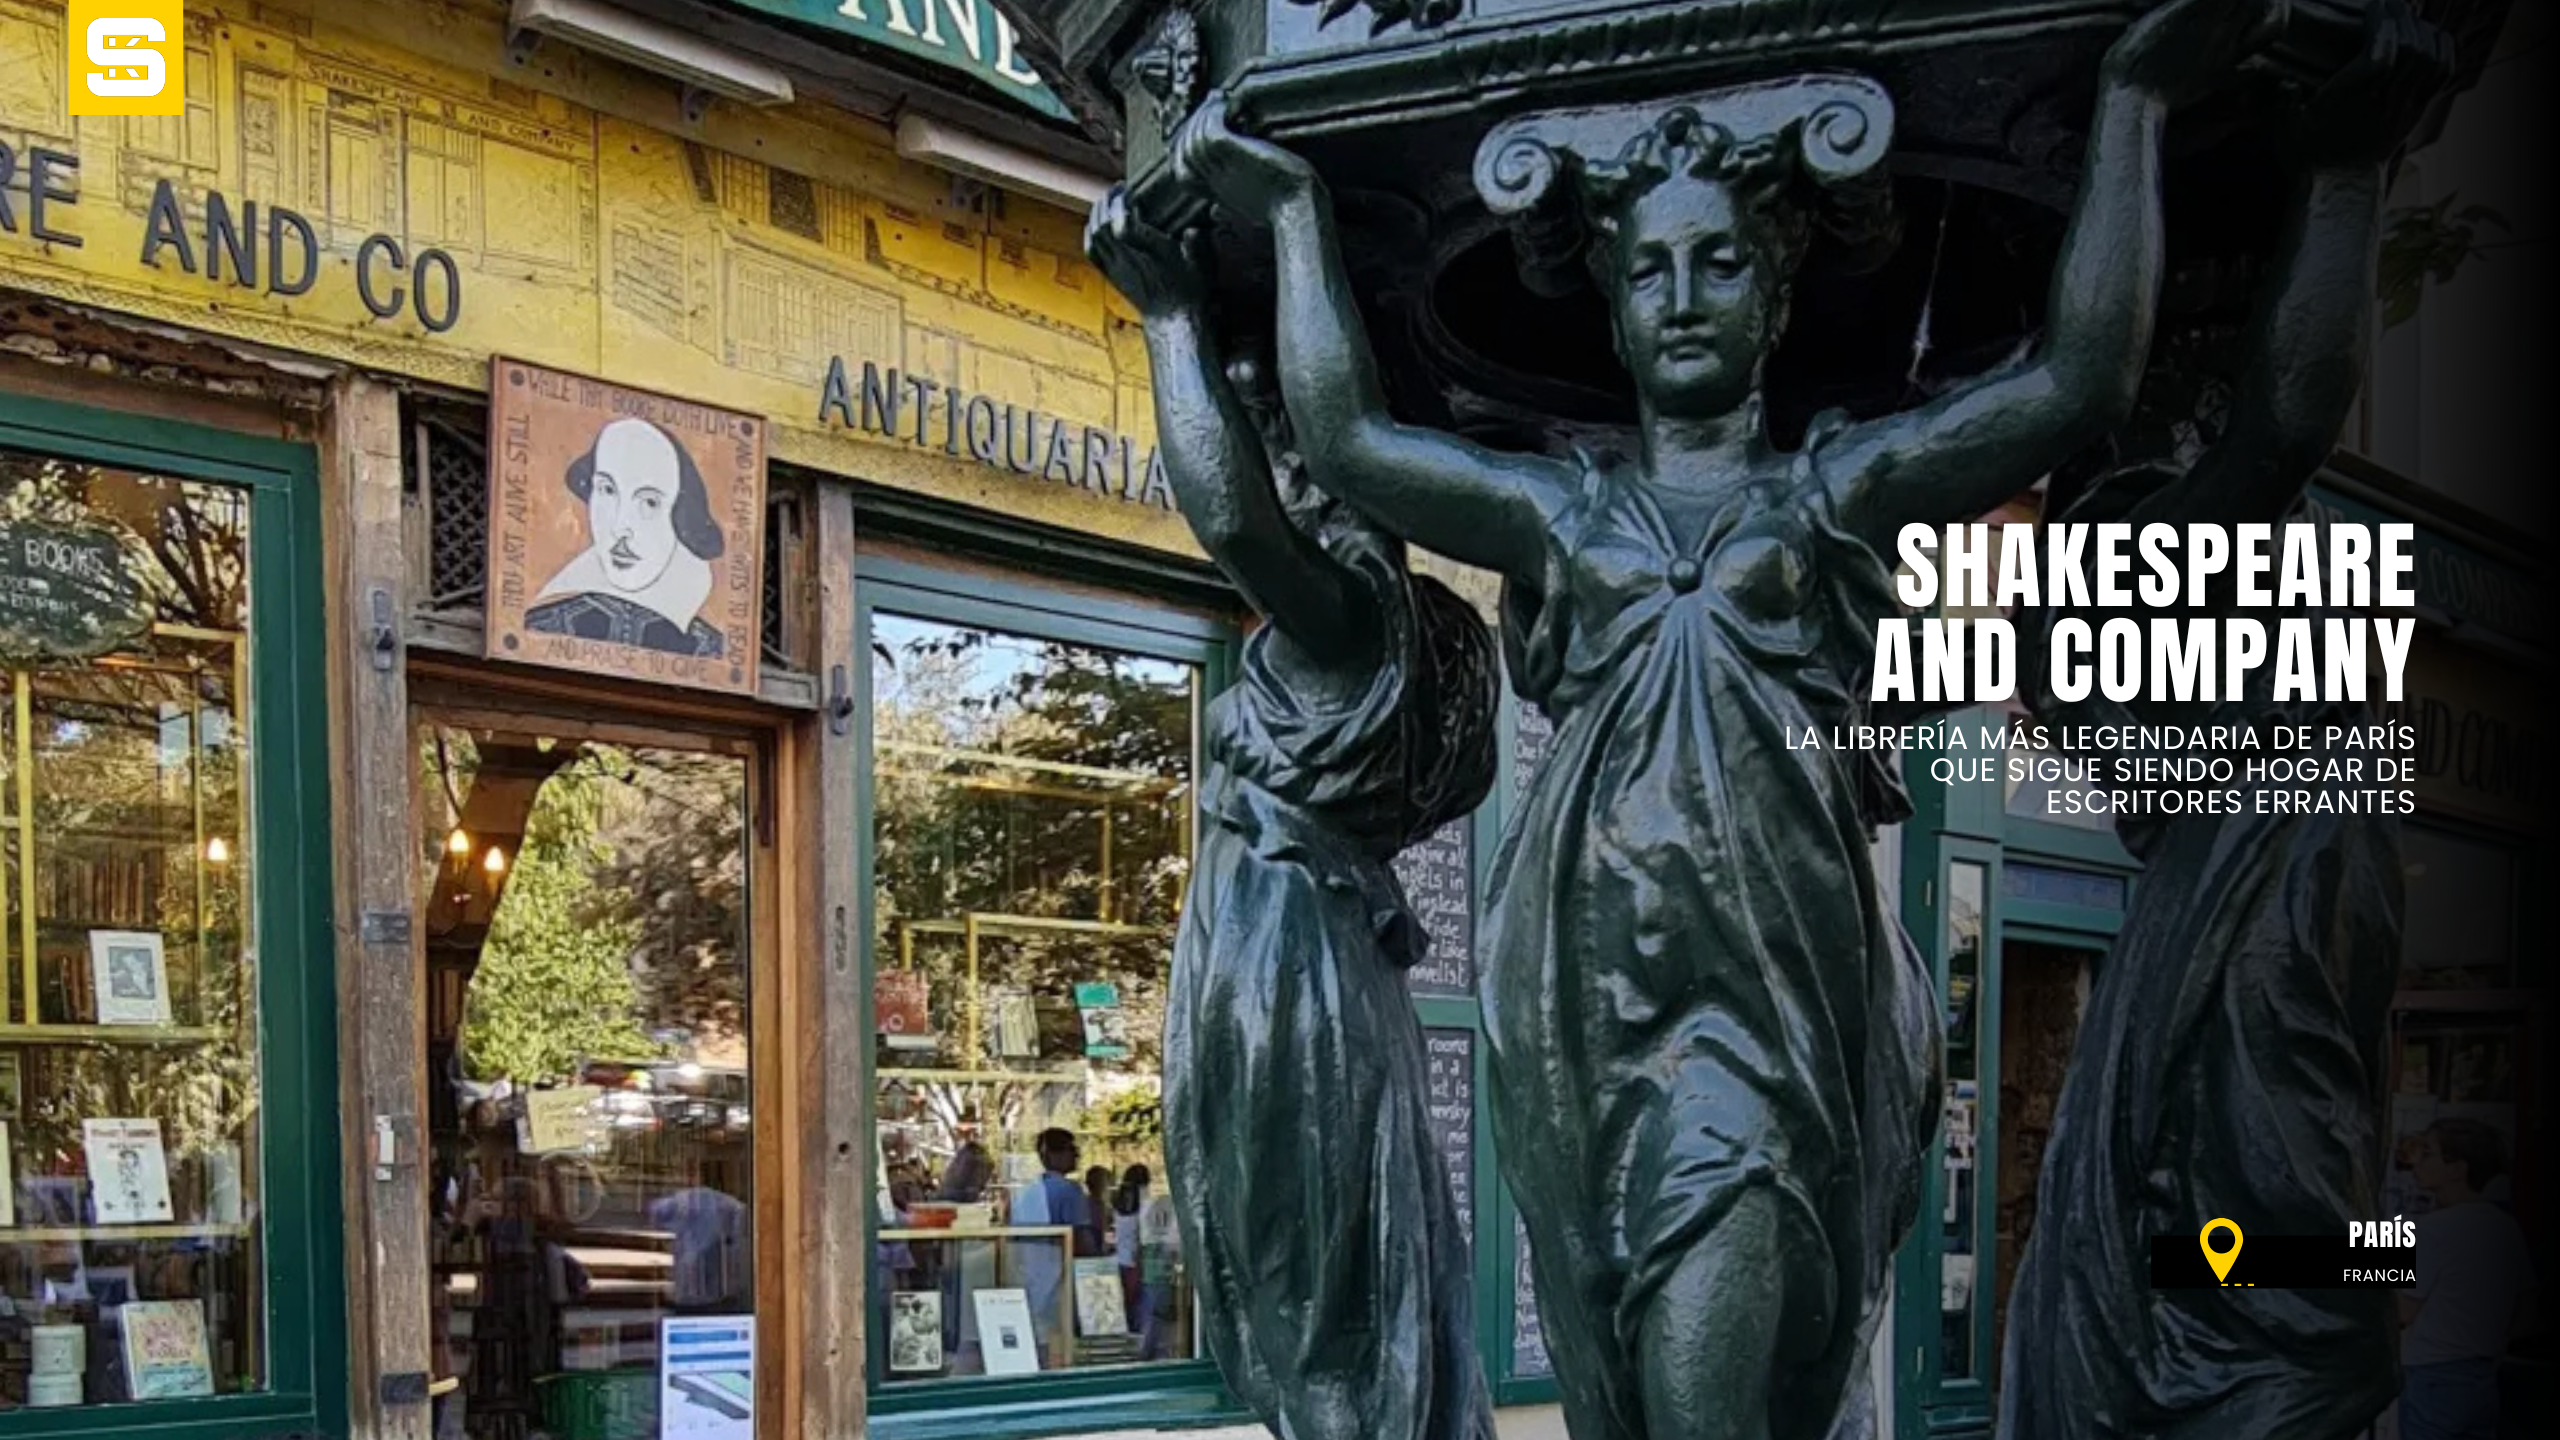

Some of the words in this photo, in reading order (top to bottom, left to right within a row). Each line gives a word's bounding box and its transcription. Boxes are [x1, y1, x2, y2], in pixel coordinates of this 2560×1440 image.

[468, 112, 503, 134] AND
[508, 122, 576, 153] COMPANY
[140, 178, 320, 297] AND
[356, 231, 461, 333] CO
[528, 367, 571, 403] WHILE
[577, 378, 604, 408] THY
[701, 405, 740, 441] LIVE
[505, 412, 531, 466] STILL
[732, 434, 755, 473] AND
[818, 354, 1176, 512] ANTIQUARIA
[505, 469, 528, 524] ALIVE
[732, 474, 754, 499] WE
[24, 538, 104, 579] BOOKS
[502, 530, 526, 568] ART
[501, 570, 526, 609] THOU
[729, 599, 750, 619] TO
[545, 637, 577, 662] AND
[671, 656, 709, 682] GIVE
[728, 623, 749, 667] READ
[1449, 871, 1465, 892] in
